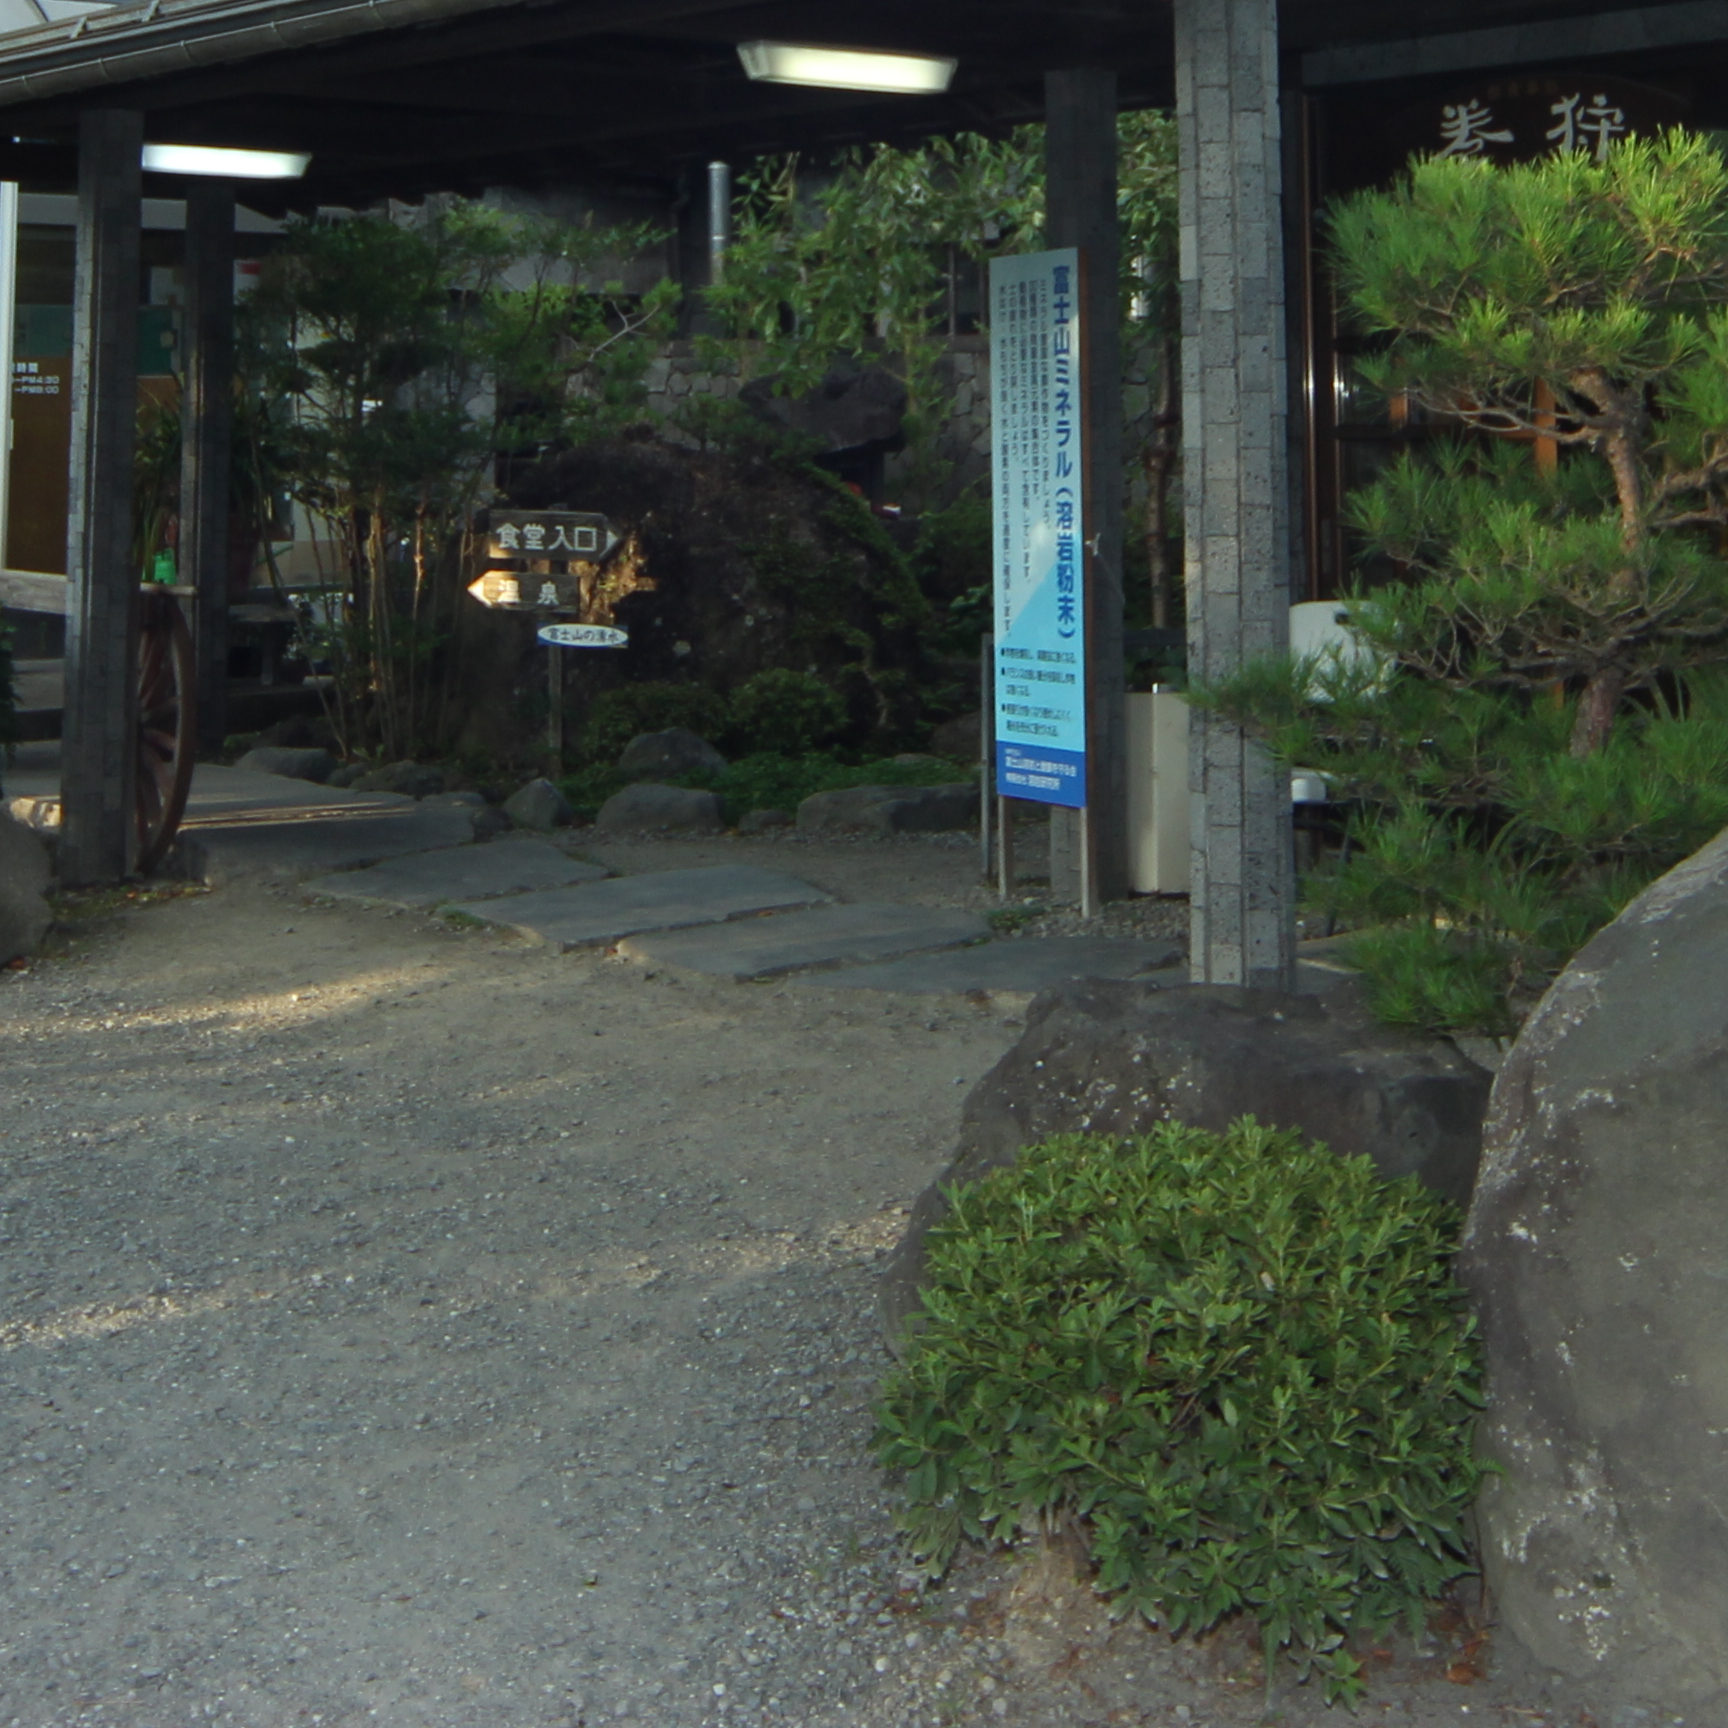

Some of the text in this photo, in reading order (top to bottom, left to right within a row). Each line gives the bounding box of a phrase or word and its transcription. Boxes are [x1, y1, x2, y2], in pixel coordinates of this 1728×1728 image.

[495, 521, 597, 552] 食堂入口
[497, 579, 560, 606] 温泉
